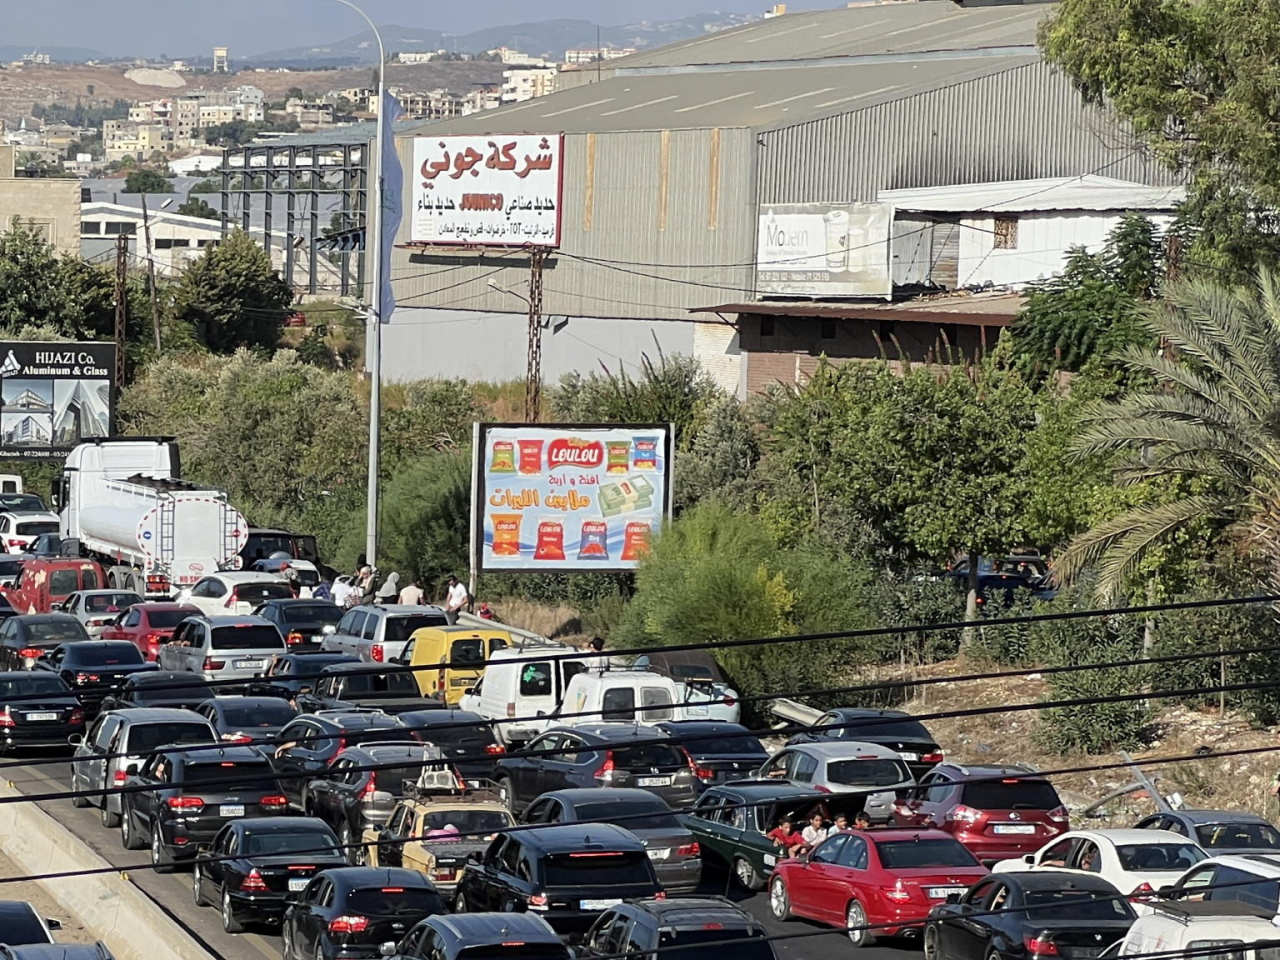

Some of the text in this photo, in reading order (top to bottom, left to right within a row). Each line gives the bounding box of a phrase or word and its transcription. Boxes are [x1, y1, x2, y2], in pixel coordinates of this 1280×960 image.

[421, 137, 553, 189] شركة جوني
[35, 352, 95, 364] HIJAZI Co.
[22, 366, 70, 375] Aluminum
[72, 366, 81, 375] &
[83, 366, 108, 376] Glass
[552, 448, 598, 463] LOULOU
